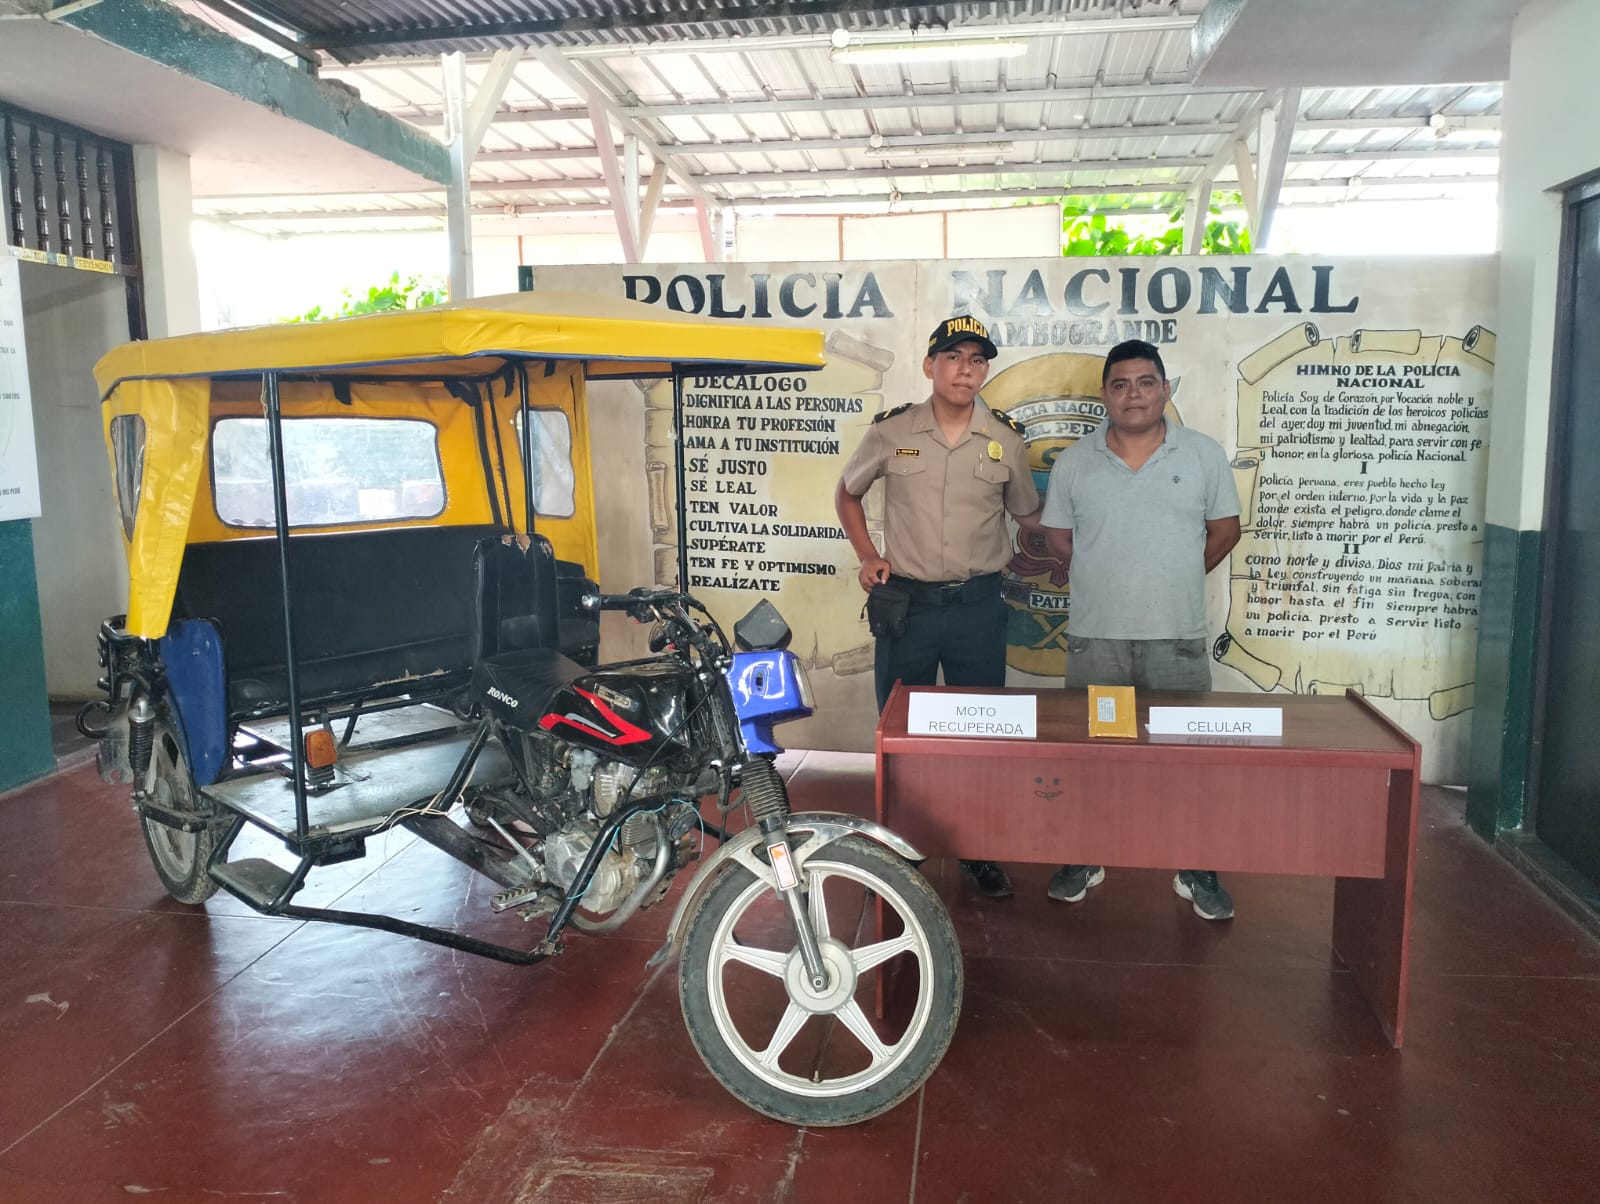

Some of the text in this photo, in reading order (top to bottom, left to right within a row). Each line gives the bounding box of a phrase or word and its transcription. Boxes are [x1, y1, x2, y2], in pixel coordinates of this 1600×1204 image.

[622, 266, 1359, 318] POLICIA NACIONAL
[990, 319, 1177, 347] AMBOGRANDE
[1296, 365, 1460, 376] HIMNO DE LA POLICIA
[1336, 378, 1425, 388] NACIONAL
[686, 394, 863, 413] DIGNIFICA A LAS PERSONAS
[1323, 391, 1335, 403] de
[1380, 394, 1394, 405] por
[1437, 393, 1464, 405] noble
[1468, 396, 1474, 406] y
[1290, 406, 1307, 415] con
[1311, 404, 1320, 415] la
[1373, 405, 1386, 416] de
[1389, 405, 1403, 416] los
[1406, 405, 1446, 417] heroicos
[685, 415, 835, 432] HONRA TU PROFESIÓN
[1260, 416, 1275, 428] del
[1307, 417, 1325, 431] doy
[1329, 418, 1342, 430] mi
[1395, 420, 1407, 431] mi
[686, 436, 840, 455] AMA A TU INSTITUCIÓN
[1260, 432, 1273, 444] mi
[1277, 432, 1336, 446] patriotismo
[1339, 436, 1346, 447] y
[1389, 437, 1414, 448] para
[1416, 436, 1449, 448] servir
[1450, 439, 1468, 448] con
[1469, 439, 1482, 451] fe
[1260, 449, 1266, 460] y
[1307, 451, 1318, 459] en
[1320, 447, 1330, 459] la
[1333, 447, 1373, 462] gloriosa
[689, 453, 767, 475] SÉ JUSTO
[690, 476, 757, 495] SÉ LEAL
[1366, 477, 1397, 491] pueblo
[1399, 477, 1428, 488] hecho
[1431, 478, 1446, 491] ley
[1260, 491, 1277, 503] por
[1281, 490, 1290, 500] el
[1295, 490, 1325, 501] orden
[1369, 494, 1386, 504] por
[1388, 491, 1397, 502] la
[1401, 493, 1422, 503] vida
[1427, 496, 1434, 505] y
[1438, 493, 1446, 503] la
[690, 500, 778, 517] TEN VALOR
[1258, 503, 1289, 514] donde
[1294, 504, 1326, 514] exista
[1331, 504, 1342, 515] el
[1385, 505, 1417, 517] donde
[1419, 506, 1450, 517] clame
[1452, 507, 1461, 518] el
[690, 520, 848, 540] CULTIVA LA SOLIDARIDA
[1376, 521, 1389, 530] un
[1436, 520, 1468, 533] presto
[690, 536, 765, 553] SUPÉRATE
[1293, 530, 1313, 540] listo
[1316, 533, 1323, 541] a
[1327, 531, 1358, 542] morir
[1362, 533, 1381, 545] por
[1384, 533, 1393, 543] el
[1343, 543, 1361, 554] II
[690, 557, 836, 575] TEN FE Y OPTIMISMO
[1286, 554, 1319, 566] norte
[1322, 559, 1330, 570] y
[1378, 558, 1403, 570] Dios
[1408, 559, 1423, 571] mi
[1466, 564, 1473, 575] y
[691, 572, 780, 591] REALÍZATE
[1292, 570, 1364, 583] construyendo
[1369, 575, 1382, 583] un
[1251, 582, 1257, 593] y
[1322, 583, 1340, 594] sin
[1346, 583, 1382, 598] fatiga
[1387, 586, 1405, 597] sin
[1247, 593, 1282, 605] honor
[1289, 595, 1325, 607] hasta
[1333, 597, 1345, 607] el
[1354, 597, 1374, 609] fin
[1246, 611, 1260, 619] un
[1320, 613, 1359, 626] presto
[1434, 617, 1462, 629] listo
[1245, 628, 1252, 636] a
[1257, 626, 1295, 637] morir
[1303, 629, 1324, 640] por
[1329, 629, 1340, 639] el
[486, 686, 519, 708] RONCO
[955, 705, 996, 717] MOTO
[928, 721, 1024, 735] RECUPERADA
[1187, 720, 1252, 733] CELULAR
